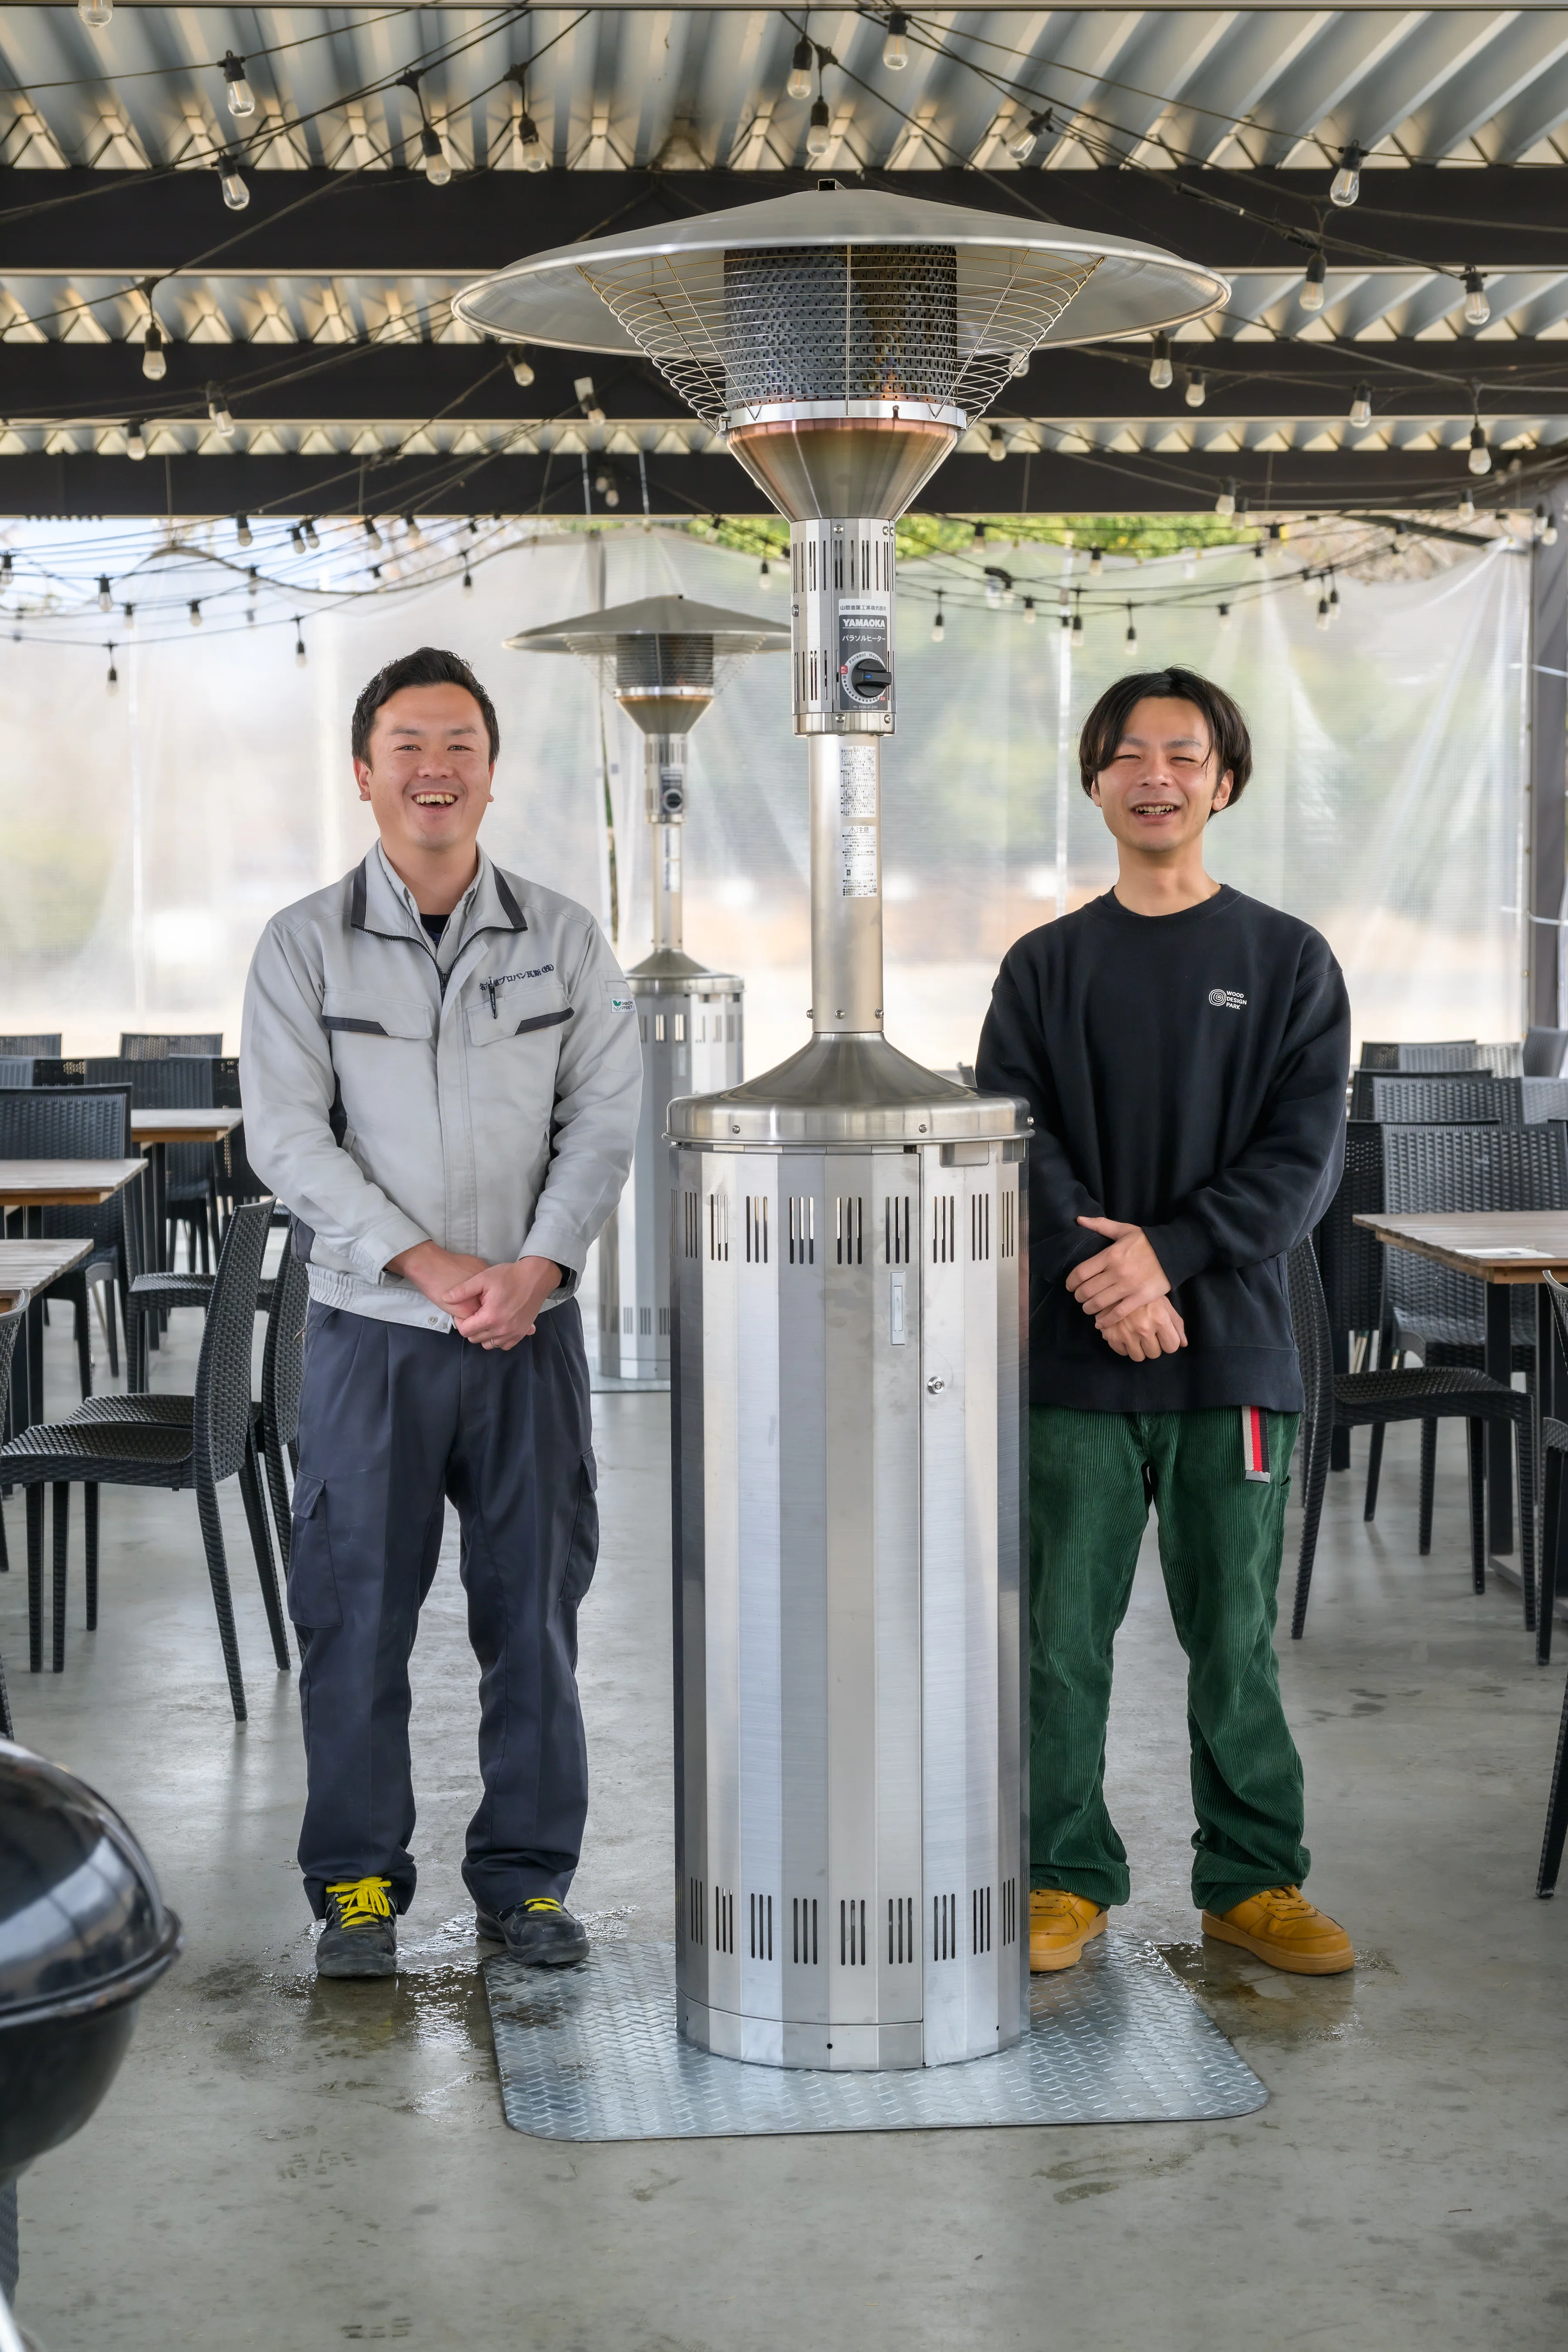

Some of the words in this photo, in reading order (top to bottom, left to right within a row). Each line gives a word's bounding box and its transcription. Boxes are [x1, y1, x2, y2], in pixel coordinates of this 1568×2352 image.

[842, 619, 885, 628] YAMAOKA
[848, 653, 866, 664] Parasol
[869, 653, 880, 662] Heate
[1227, 996, 1247, 1005] DESIGN
